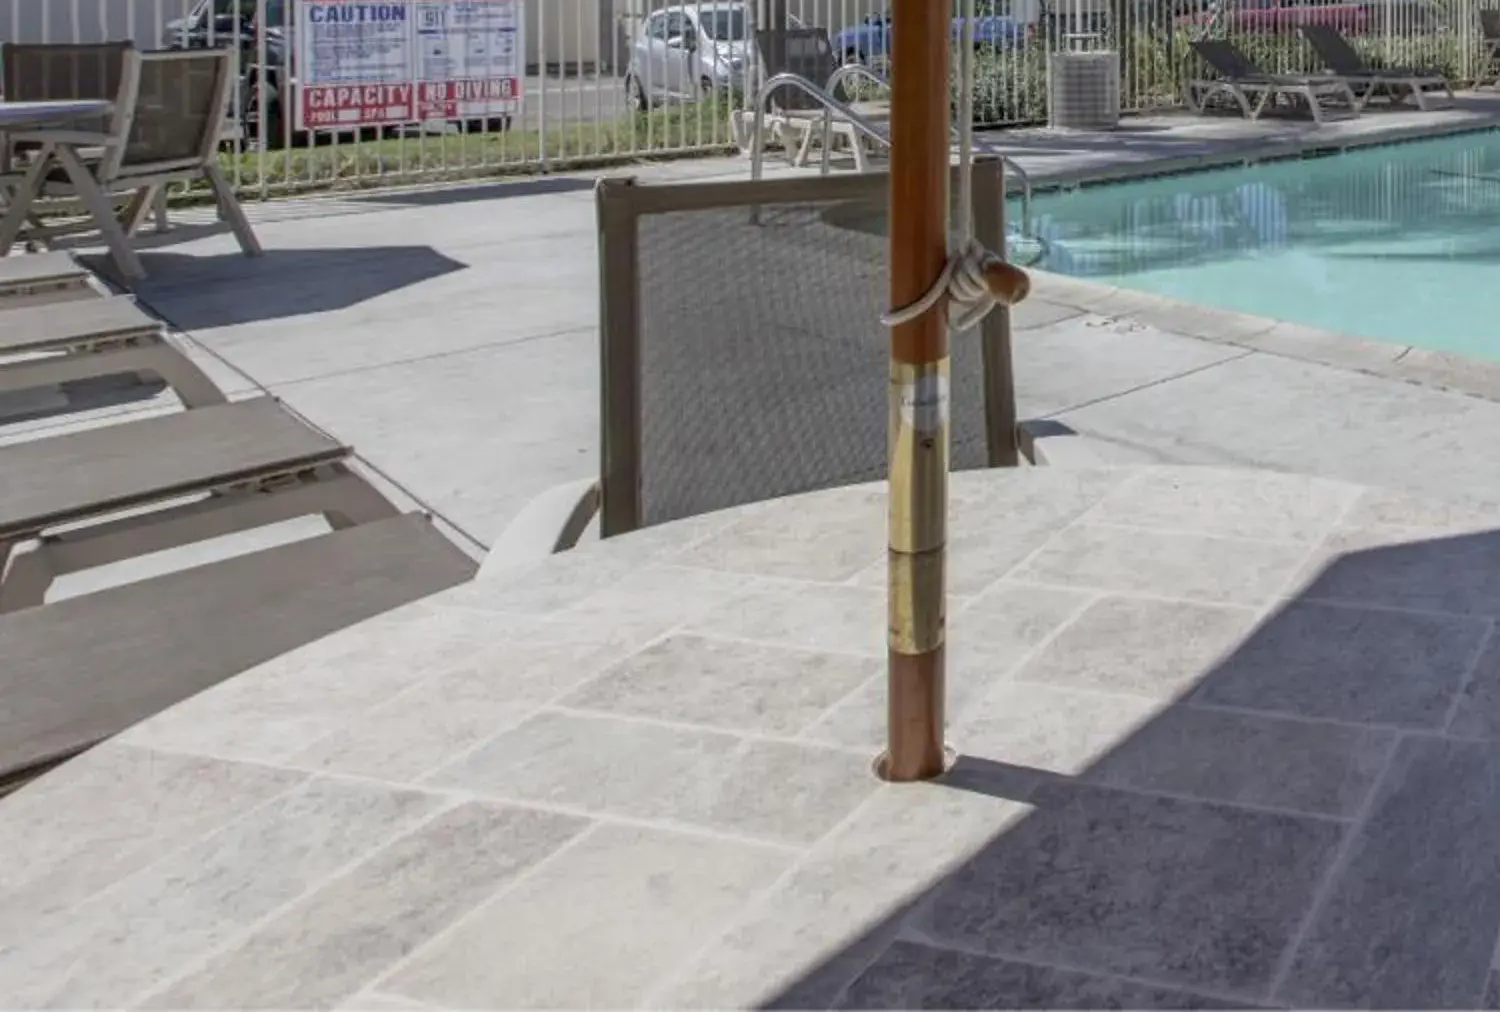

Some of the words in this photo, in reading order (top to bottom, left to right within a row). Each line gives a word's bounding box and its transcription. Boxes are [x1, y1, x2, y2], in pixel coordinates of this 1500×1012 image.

[310, 4, 406, 22] CAUTION
[310, 85, 409, 108] CAPACITY
[425, 83, 447, 103] NO
[455, 78, 511, 101] DIVING
